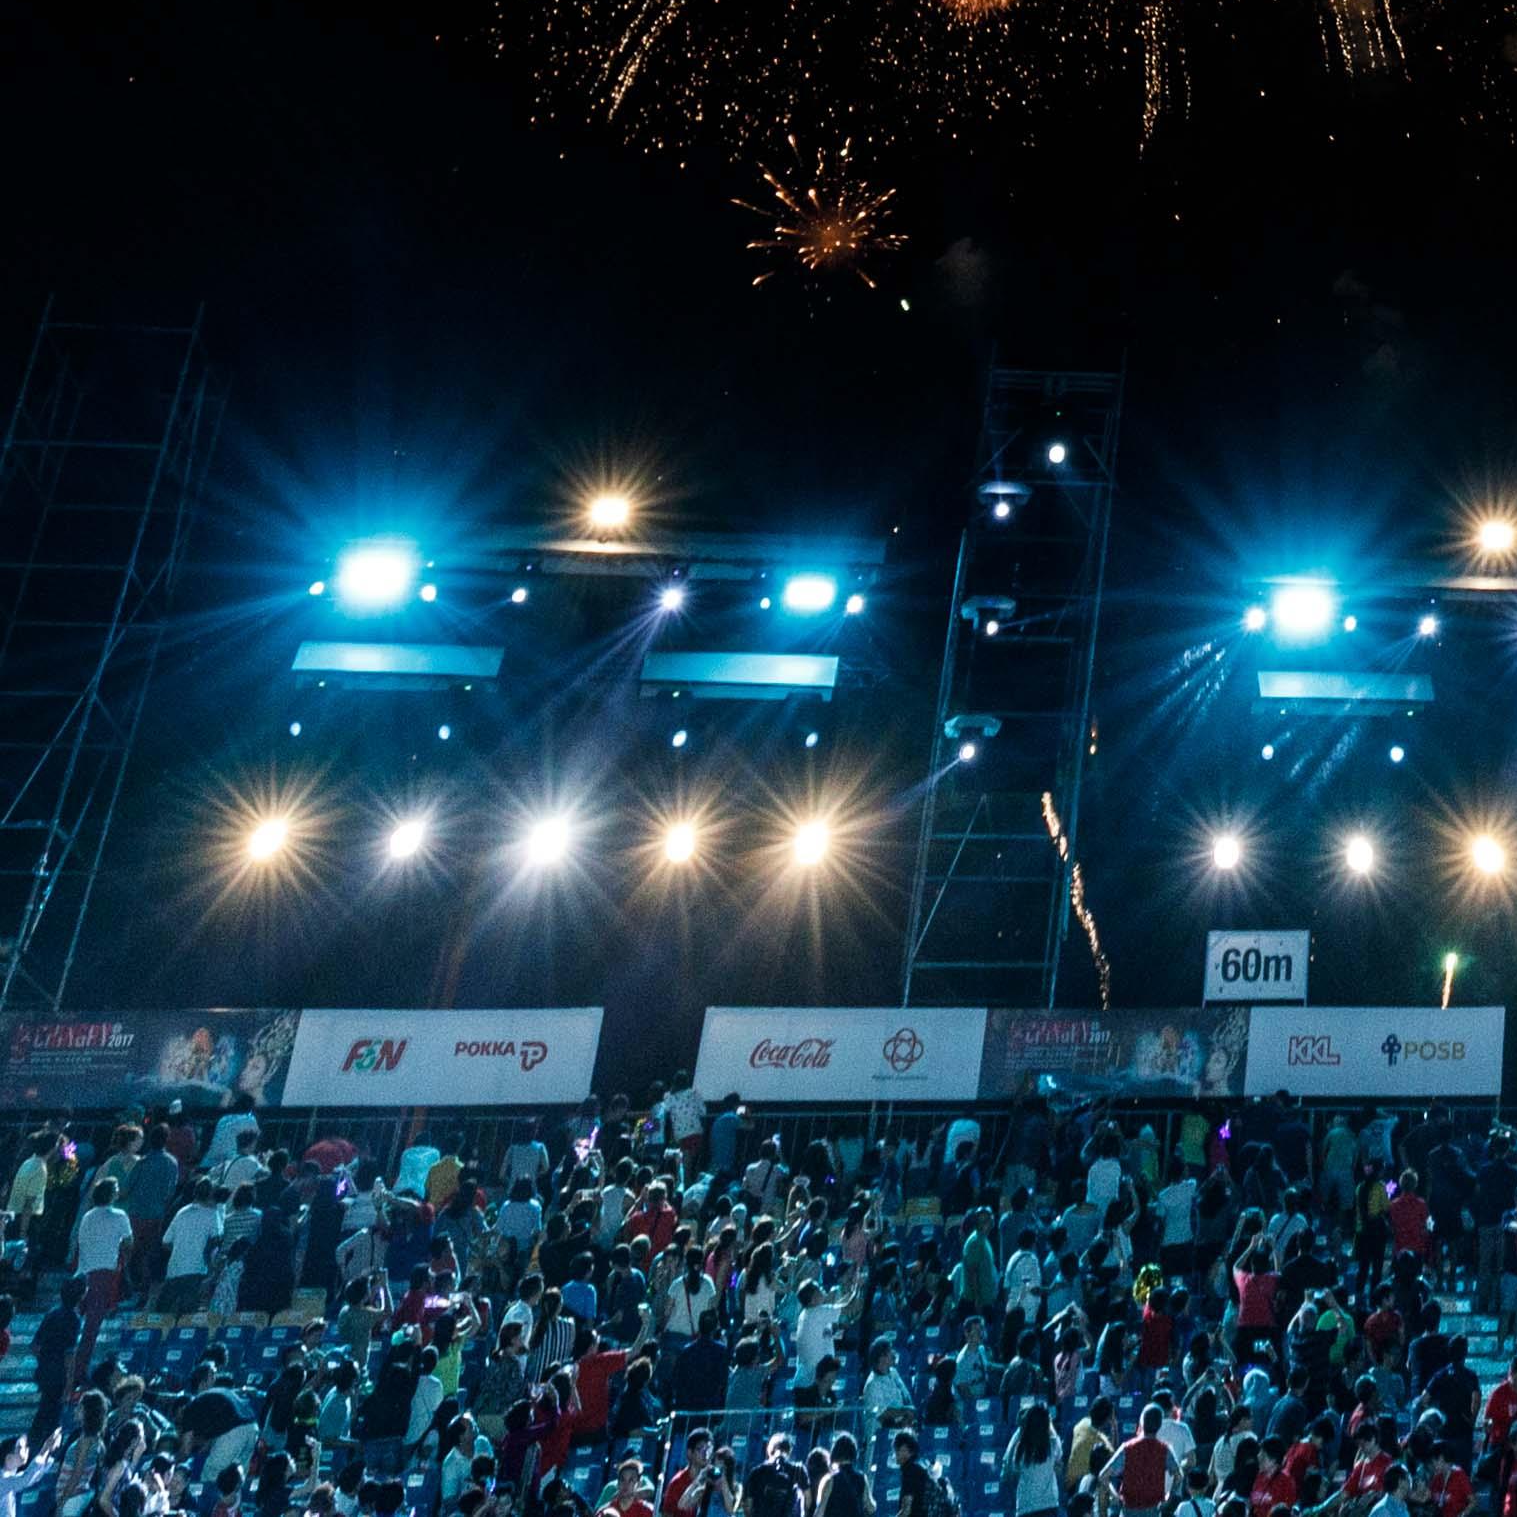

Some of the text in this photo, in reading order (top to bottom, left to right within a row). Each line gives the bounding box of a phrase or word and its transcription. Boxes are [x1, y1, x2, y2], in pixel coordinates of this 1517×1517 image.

[1220, 948, 1293, 983] 60m
[342, 1039, 408, 1072] F&N
[454, 1041, 516, 1057] POKKA
[1288, 1035, 1341, 1066] KKL
[1404, 1041, 1466, 1061] POSB
